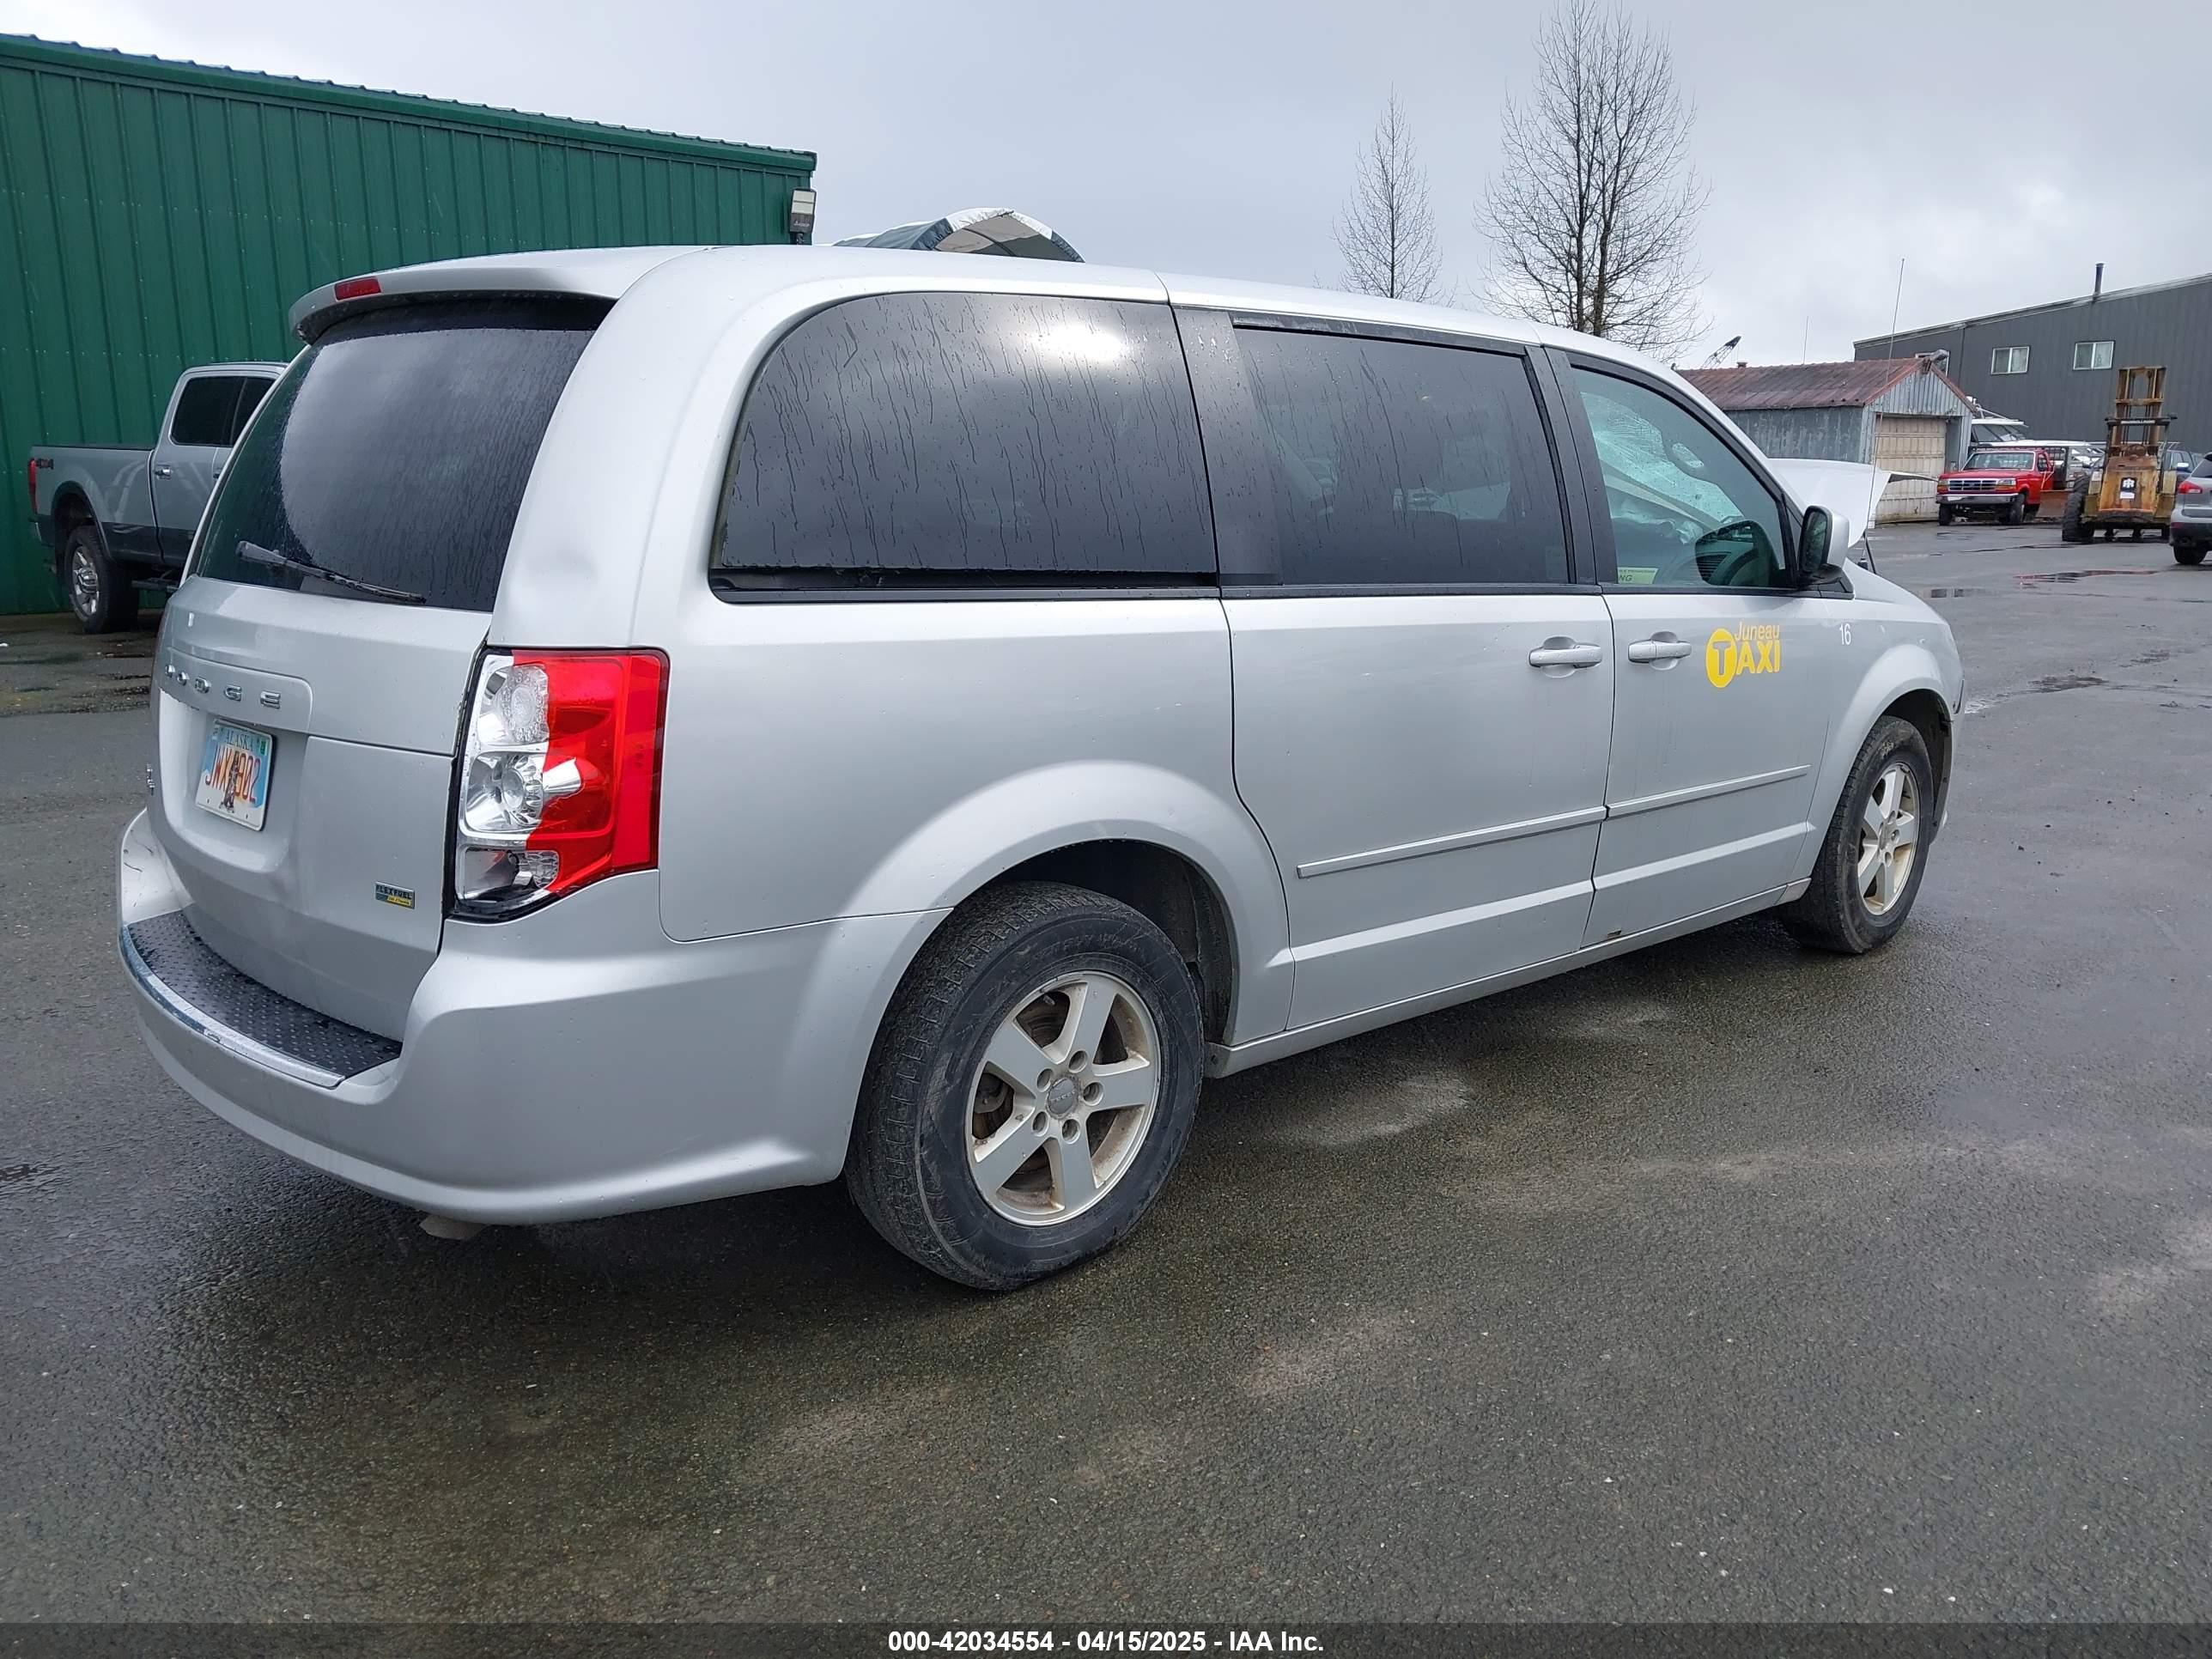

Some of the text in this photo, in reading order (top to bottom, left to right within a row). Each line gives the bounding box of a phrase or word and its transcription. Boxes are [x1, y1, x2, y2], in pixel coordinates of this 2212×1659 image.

[1734, 621, 1780, 641] Juneau
[1839, 623, 1852, 645] 16
[1712, 640, 1781, 677] TAXI
[224, 727, 255, 752] ALASKA
